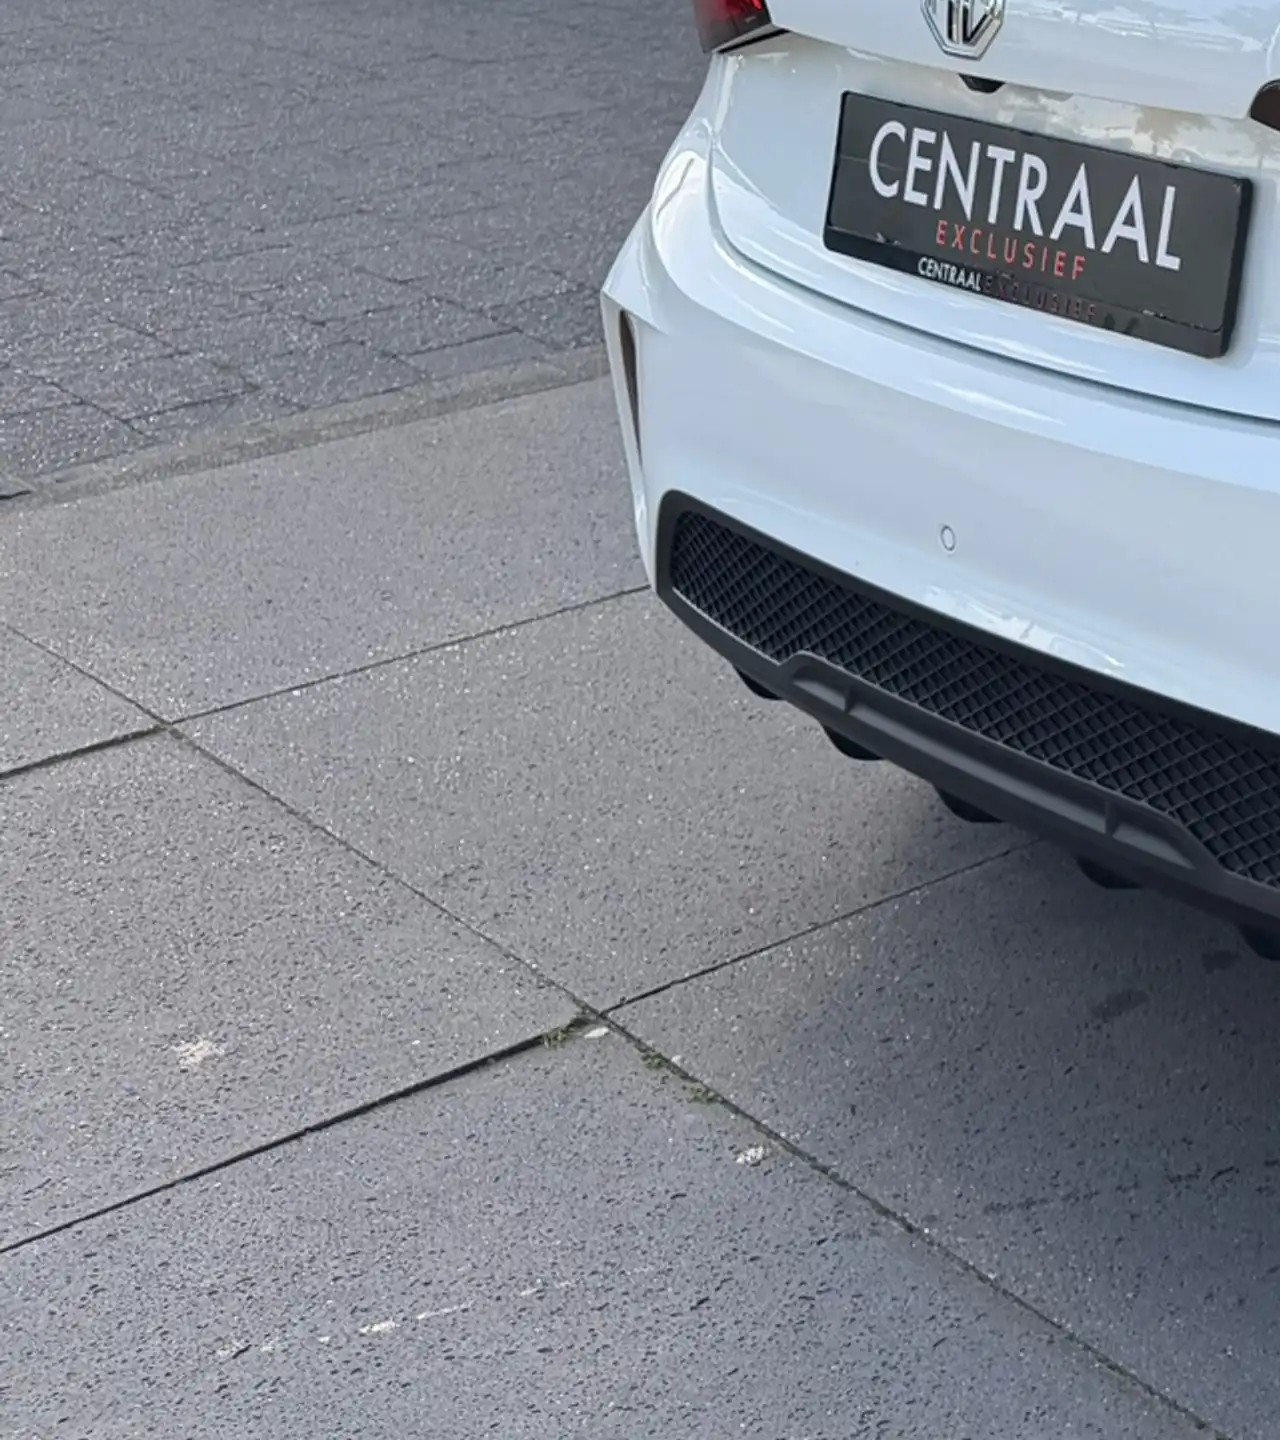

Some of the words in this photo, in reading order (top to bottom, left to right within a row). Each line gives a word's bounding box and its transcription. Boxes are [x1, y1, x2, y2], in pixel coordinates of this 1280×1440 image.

[868, 120, 1181, 271] CENTRAAL
[918, 256, 982, 291] CENTRAAL
[936, 219, 1086, 280] EXCLUSIEF
